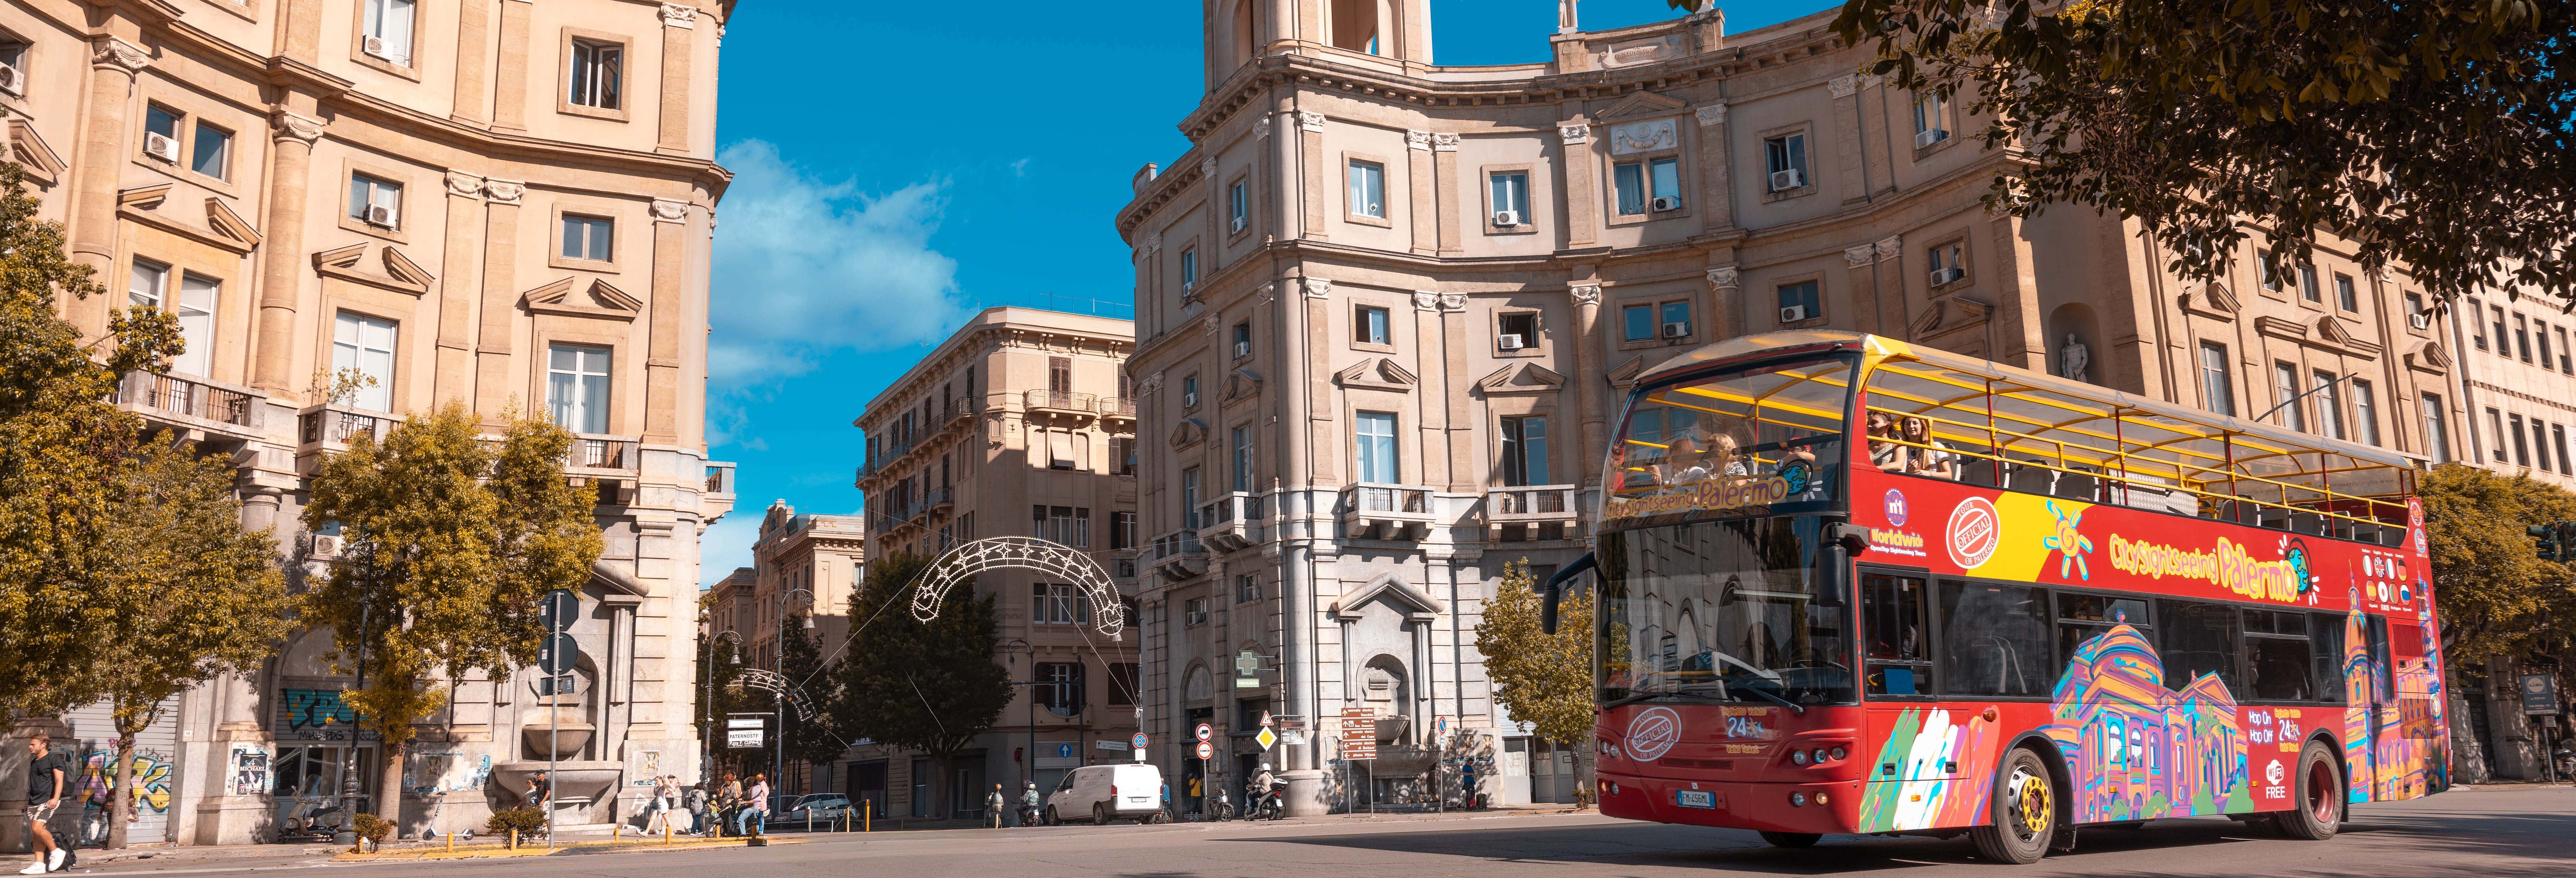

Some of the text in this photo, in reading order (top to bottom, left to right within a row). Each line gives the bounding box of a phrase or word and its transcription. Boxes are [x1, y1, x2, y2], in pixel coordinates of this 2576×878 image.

[1698, 476, 1789, 509] Palermo
[1957, 502, 1974, 518] TOUR
[1871, 528, 1924, 548] Worldwide
[1957, 515, 1990, 548] OFFICIAL
[1965, 537, 1995, 565] OF PALERMO
[2217, 536, 2297, 603] Palermo
[1637, 711, 1656, 724] TOUR
[1722, 707, 1767, 717] Biglietto Valido
[2248, 710, 2272, 727] Hop On
[1634, 722, 1671, 745] OFFICIAL
[1727, 716, 1747, 738] 24
[2250, 728, 2273, 745] Hop Off
[2279, 718, 2291, 742] 24
[1649, 738, 1675, 758] PALERMO
[1726, 744, 1760, 754] Valid Ticket
[2266, 786, 2285, 799] FREE
